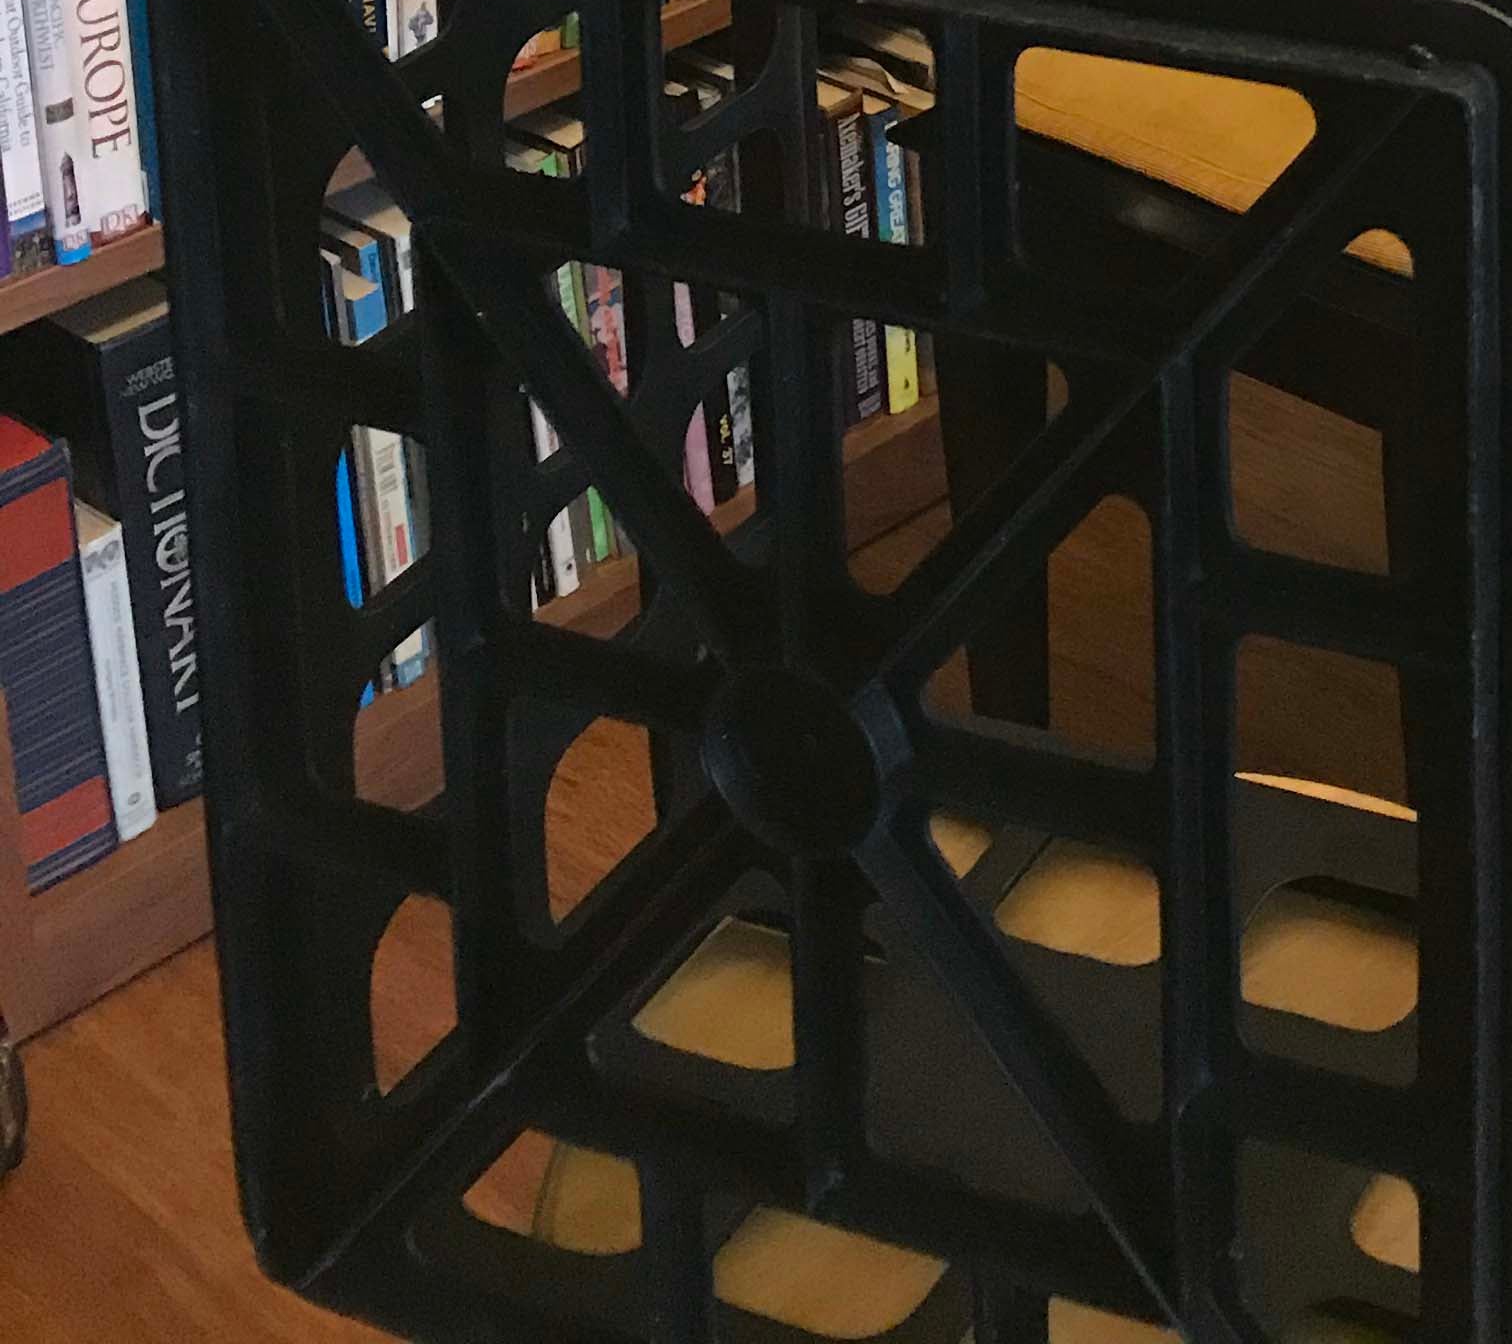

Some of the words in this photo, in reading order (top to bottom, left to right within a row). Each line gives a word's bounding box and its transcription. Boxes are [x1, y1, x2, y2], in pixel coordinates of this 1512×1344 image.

[5, 16, 25, 80] Outdoor
[14, 81, 30, 128] Guide
[20, 130, 32, 147] to
